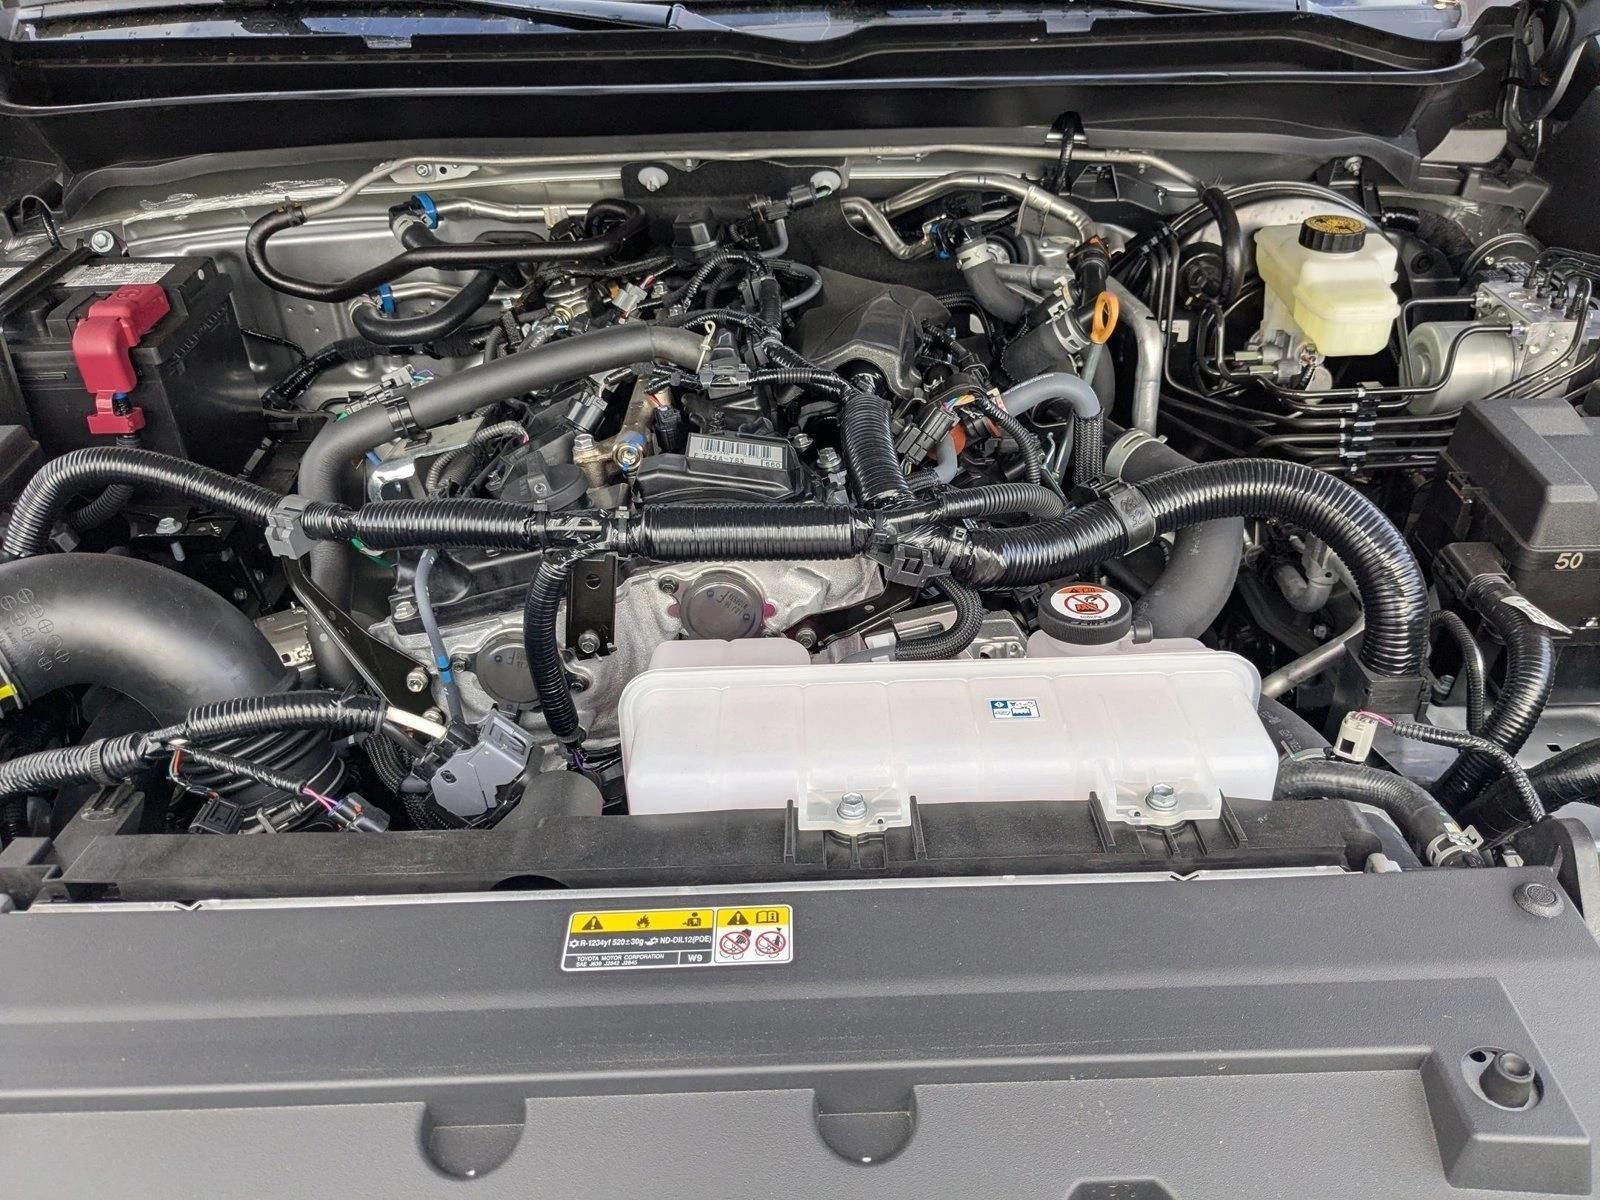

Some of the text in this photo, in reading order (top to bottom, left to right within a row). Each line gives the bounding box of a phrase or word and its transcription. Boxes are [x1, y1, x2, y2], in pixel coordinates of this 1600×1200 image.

[1554, 551, 1584, 570] 50
[580, 935, 712, 948] R-1234yf 520±30g ND-OIL12(POE)
[688, 954, 703, 962] W9
